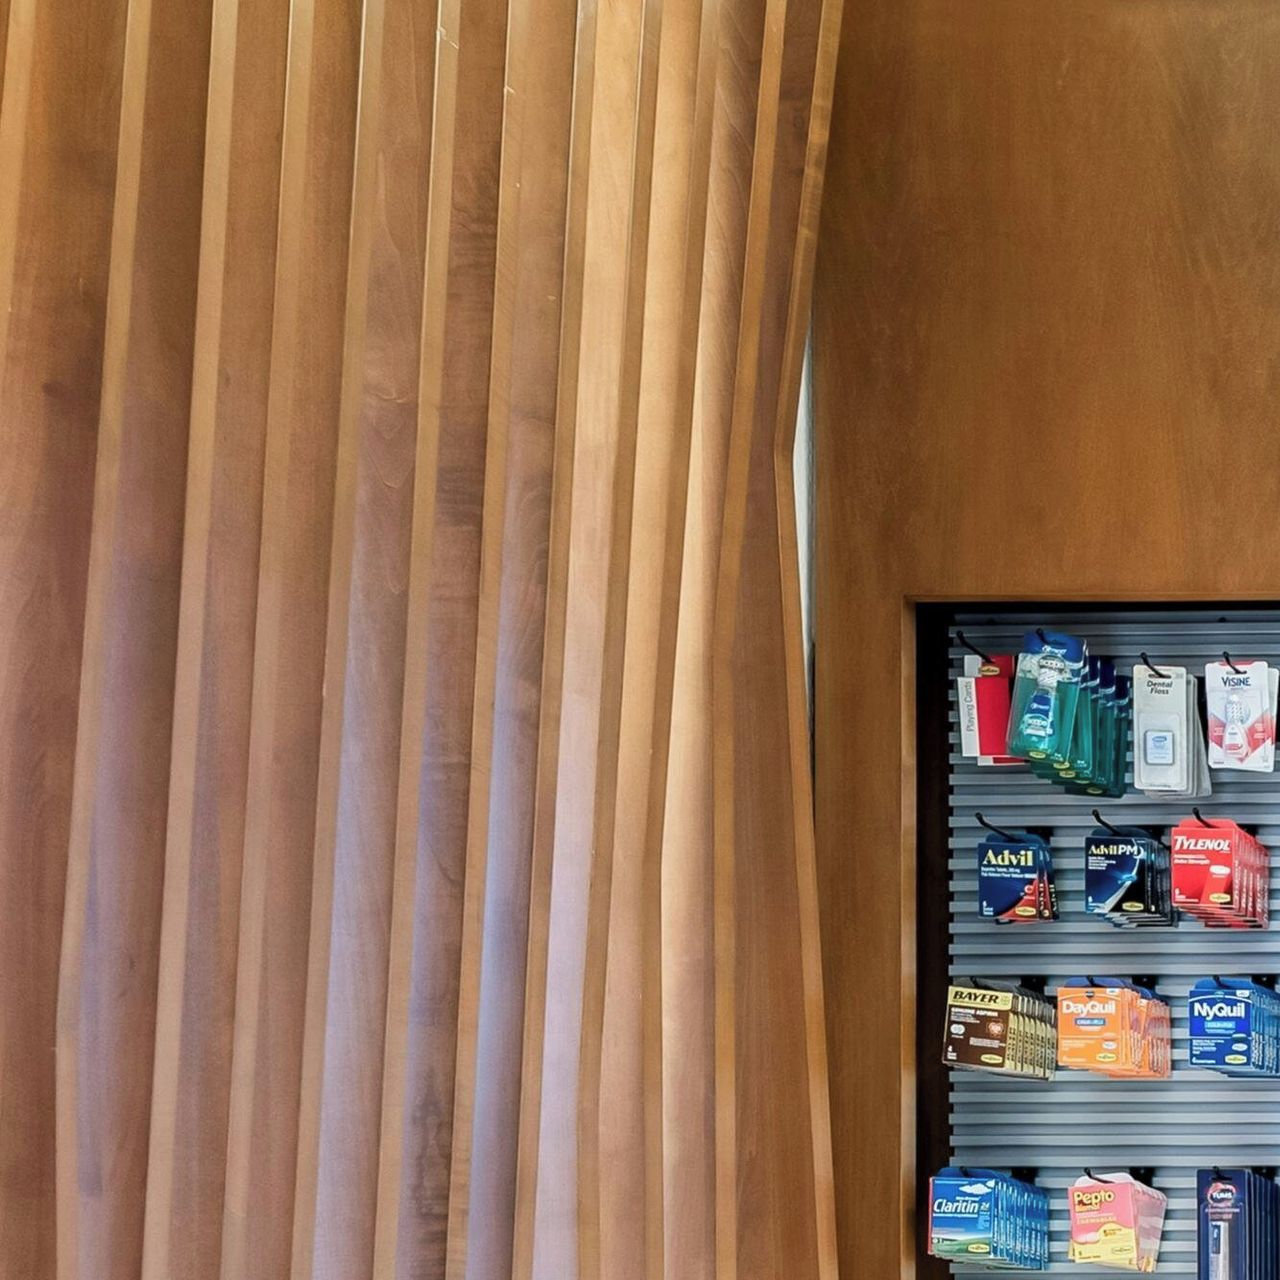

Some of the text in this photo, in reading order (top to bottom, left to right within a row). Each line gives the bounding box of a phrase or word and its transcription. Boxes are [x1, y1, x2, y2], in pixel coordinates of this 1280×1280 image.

[1146, 680, 1173, 690] Dental
[1150, 687, 1170, 696] Floss
[964, 680, 974, 732] Playing Cards
[1174, 836, 1231, 851] TYLENOL
[982, 849, 1033, 866] Advil
[953, 991, 999, 1003] BAYER
[1062, 1000, 1115, 1016] DayQuil
[1193, 1003, 1245, 1020] NyQuil
[933, 1199, 978, 1213] Claritin
[1074, 1190, 1115, 1208] Pepto
